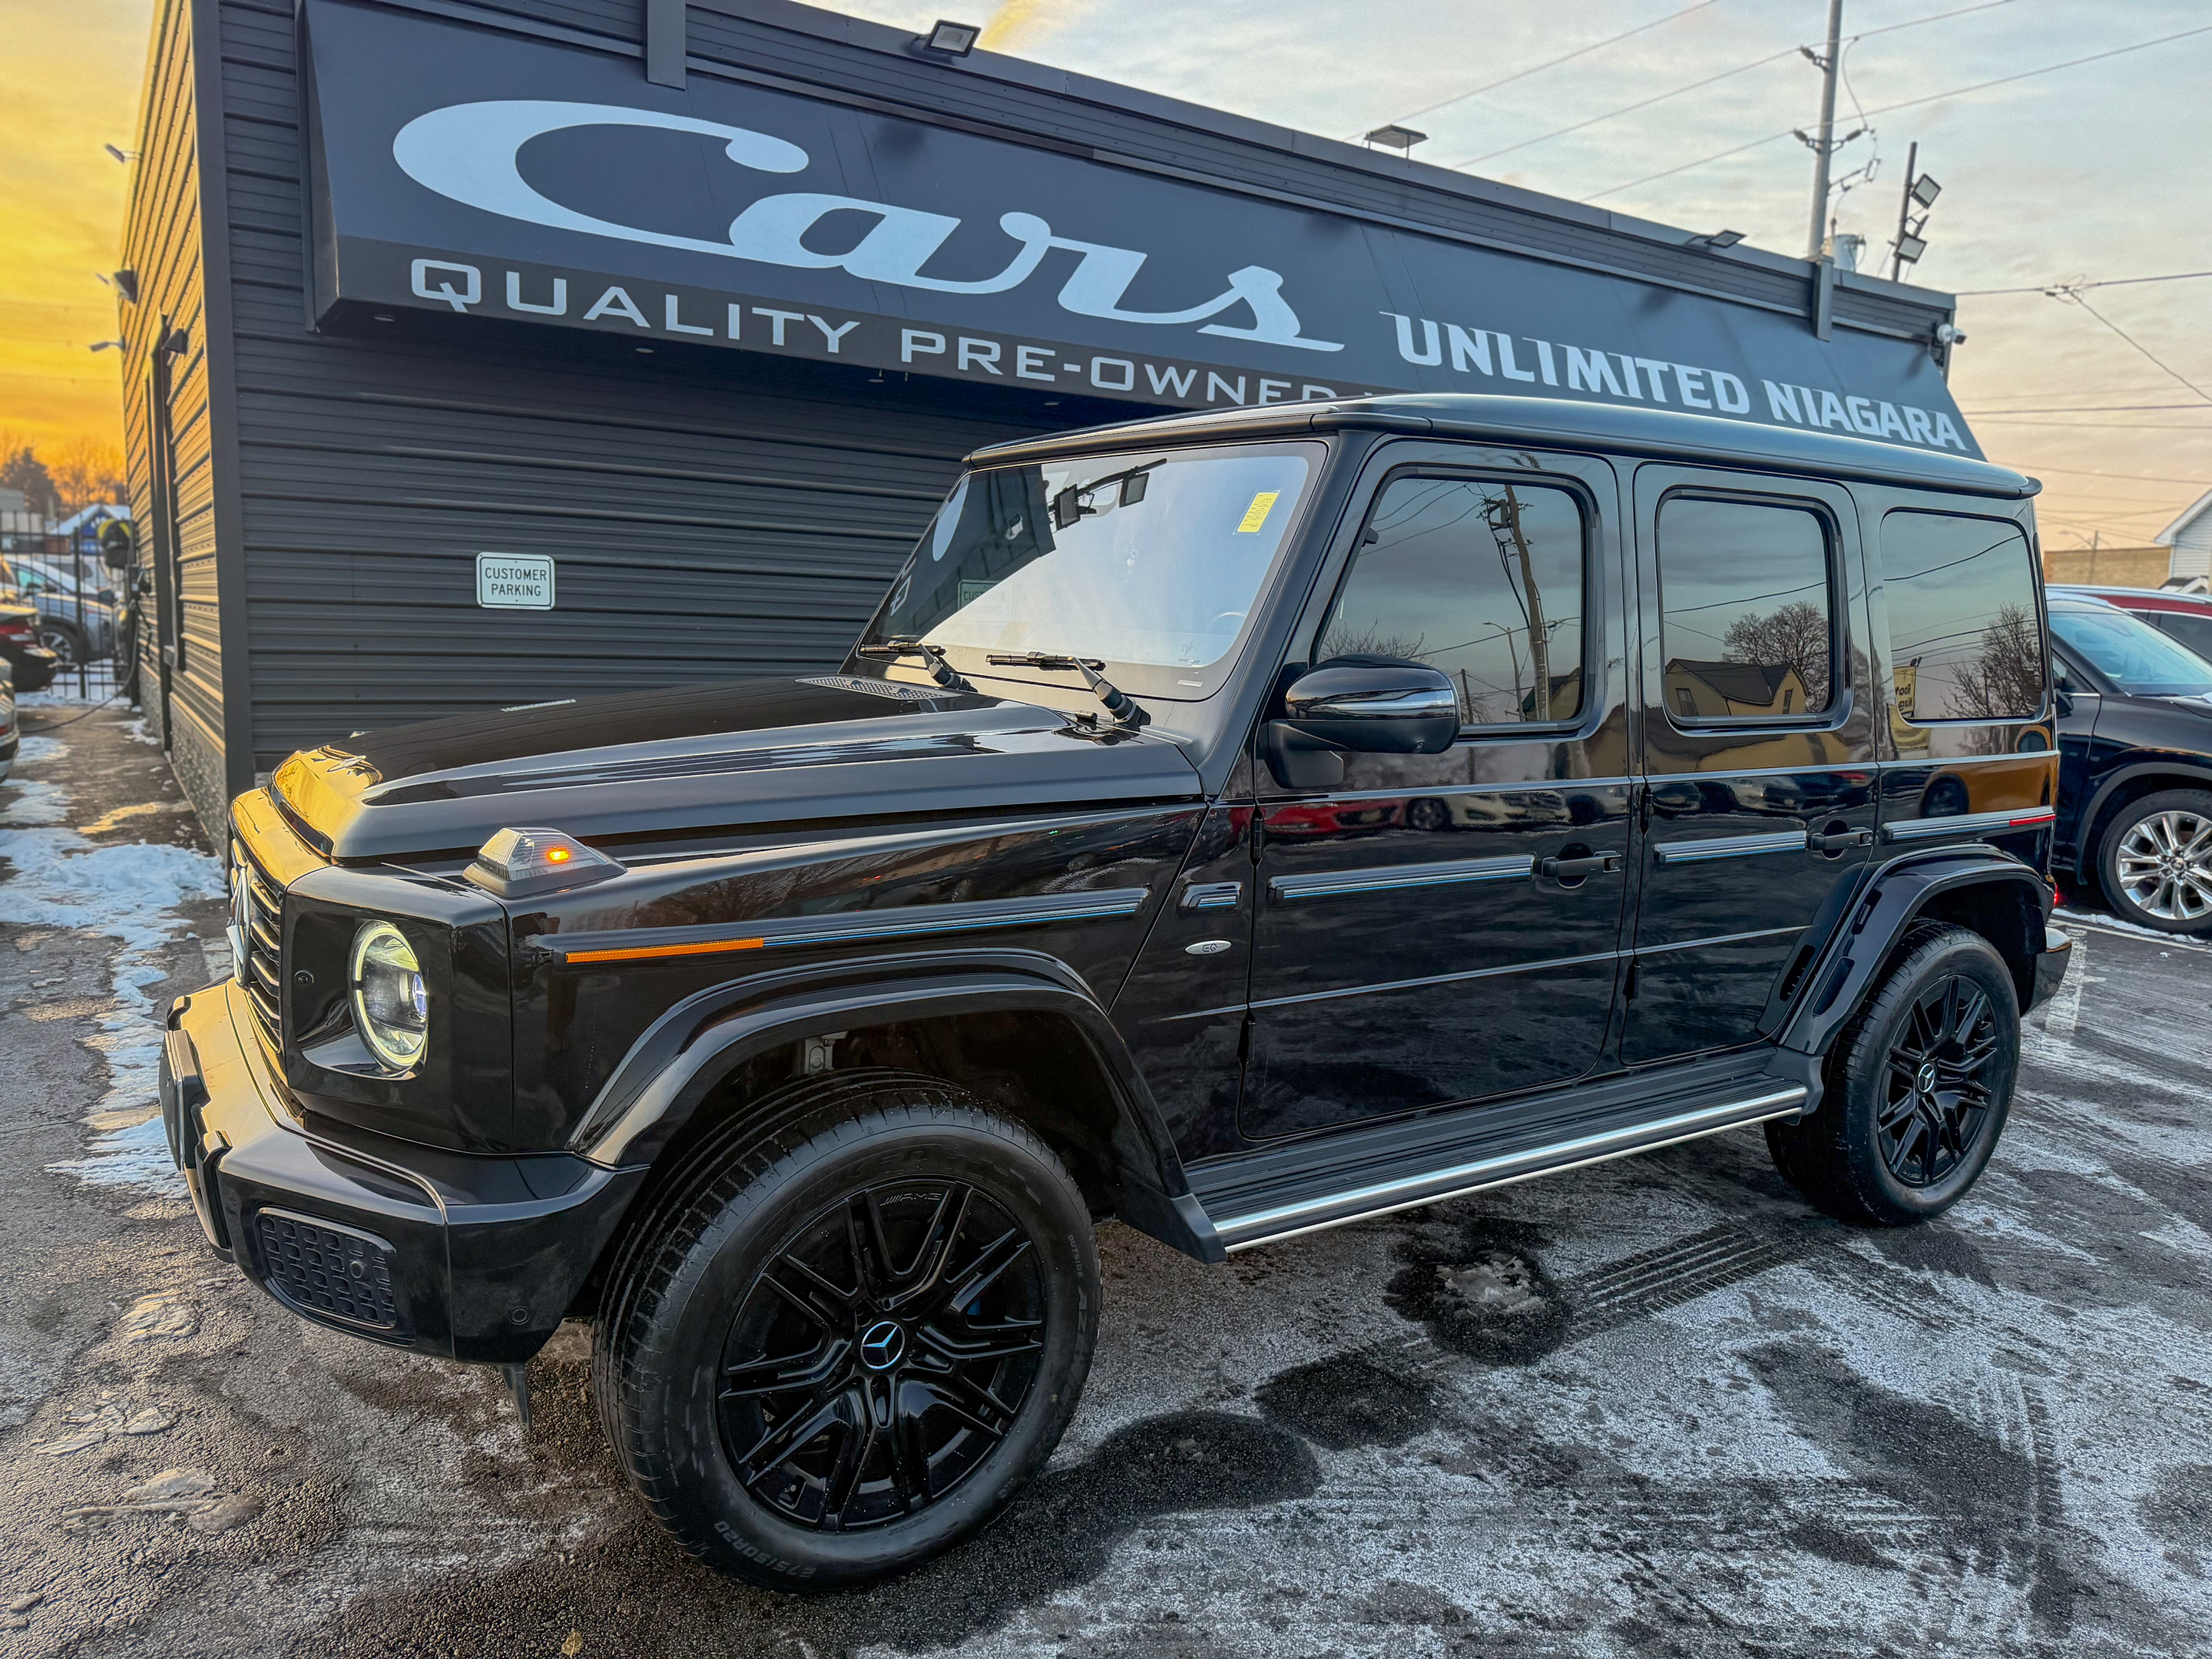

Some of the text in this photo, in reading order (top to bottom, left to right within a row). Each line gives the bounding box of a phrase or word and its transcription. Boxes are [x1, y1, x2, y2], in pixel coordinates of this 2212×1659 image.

[392, 100, 1345, 352] Cars
[411, 258, 861, 353] QUALITY
[1379, 311, 1971, 452] UNLIMITED NIAGARA
[485, 567, 547, 581] CUSTOMER
[491, 583, 541, 597] PARKING
[1203, 942, 1217, 952] EQ
